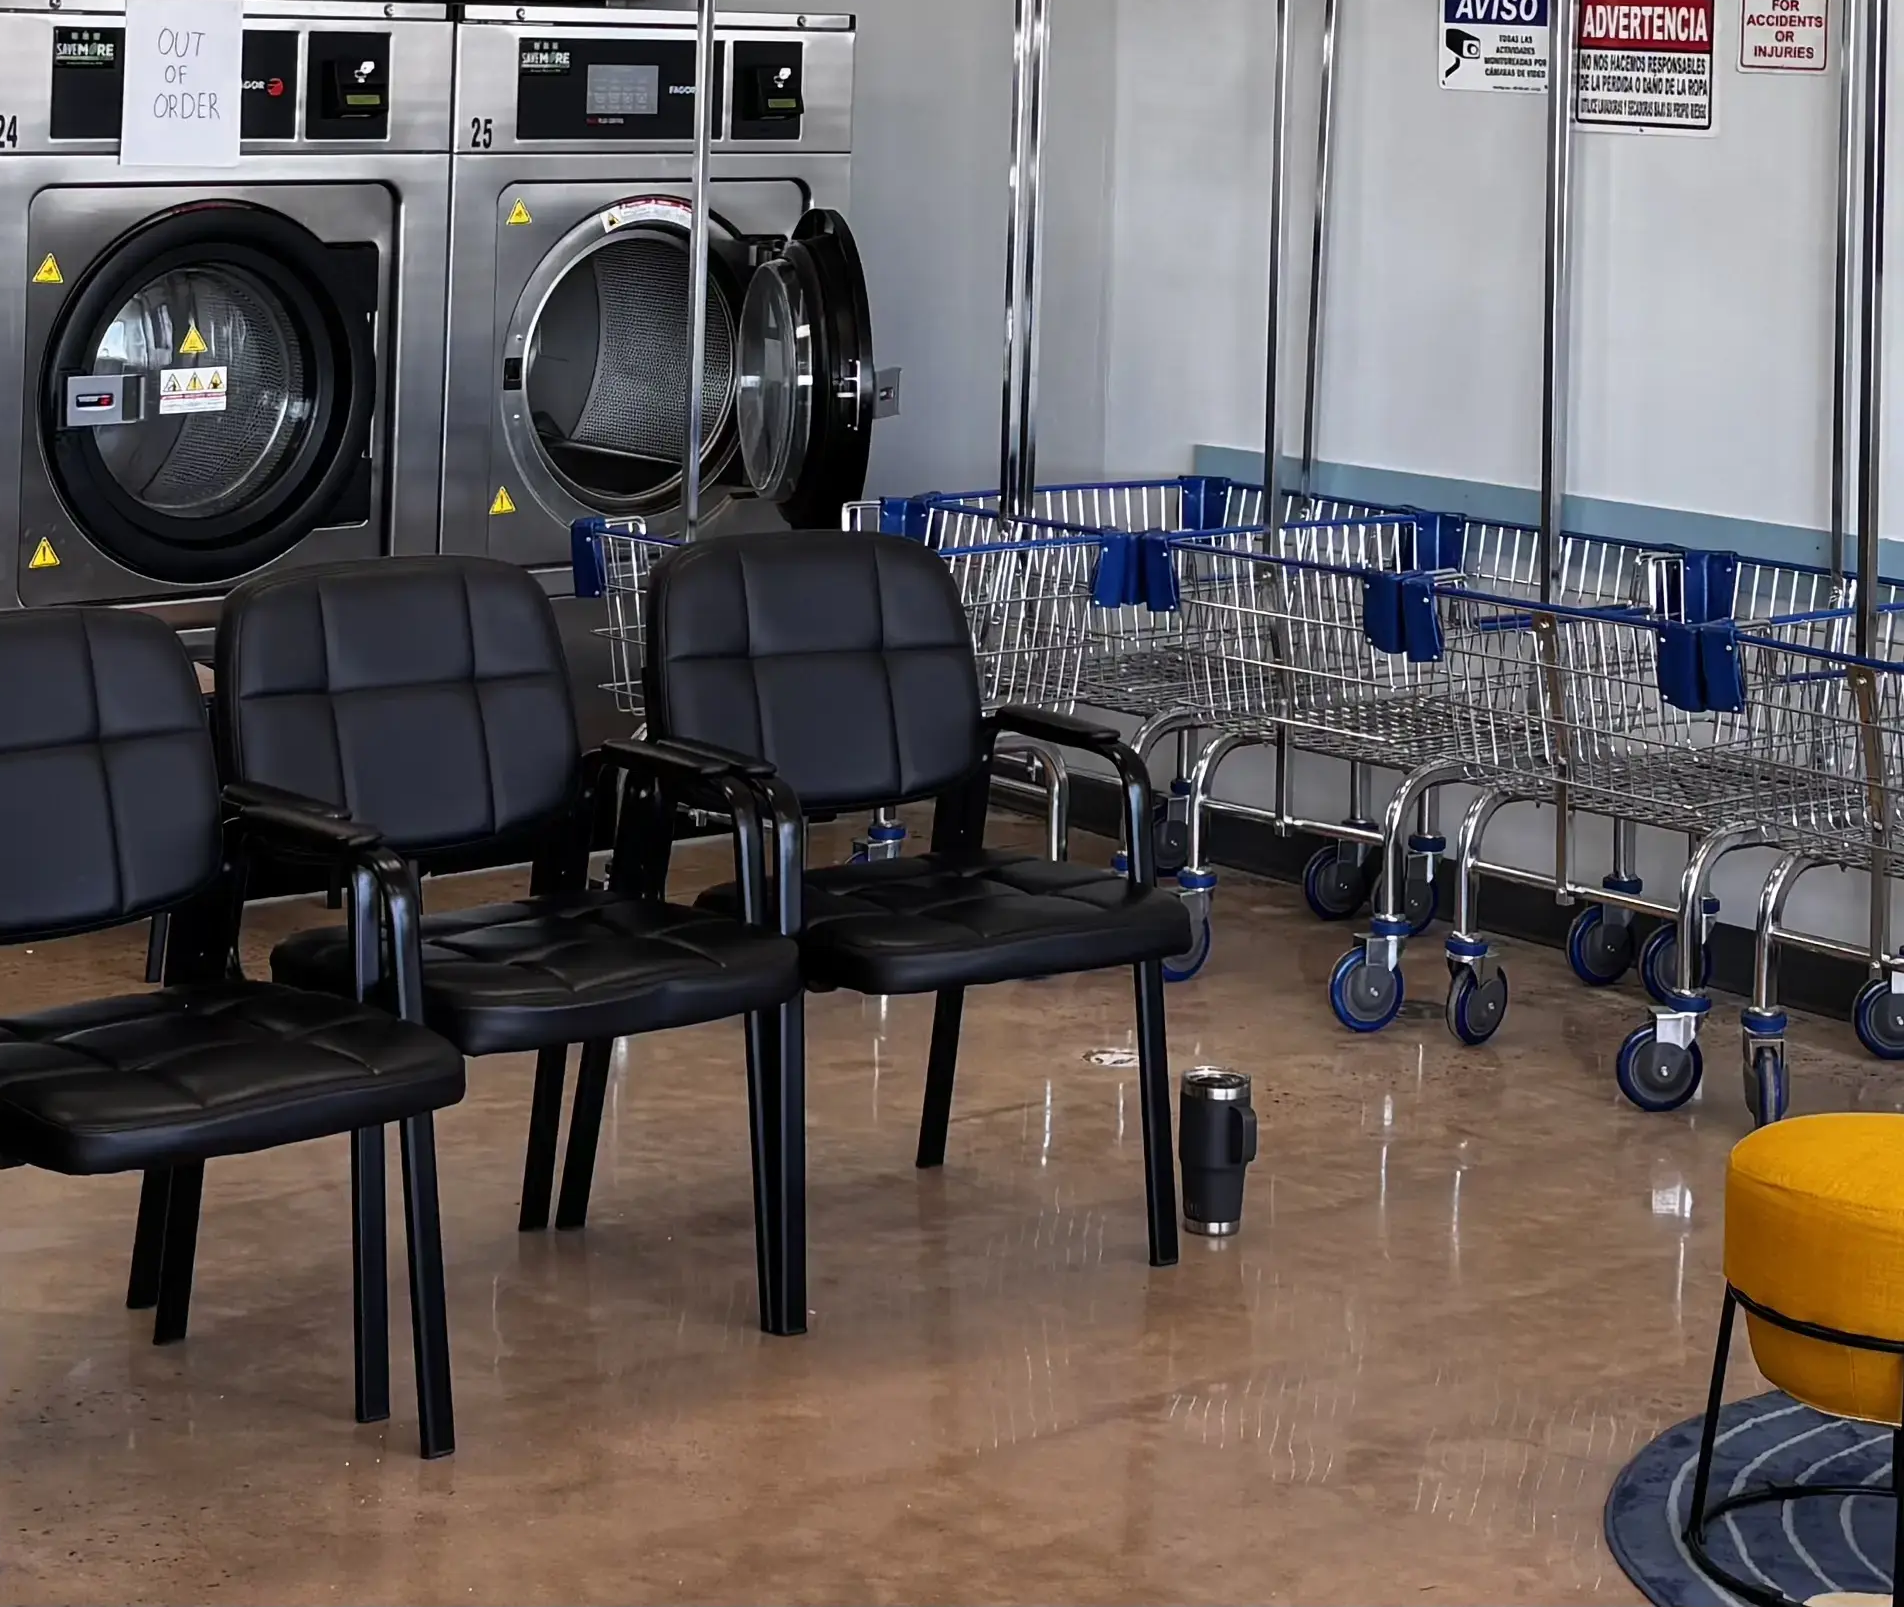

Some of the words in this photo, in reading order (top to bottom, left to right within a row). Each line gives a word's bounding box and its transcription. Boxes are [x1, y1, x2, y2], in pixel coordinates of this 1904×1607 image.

[1772, 0, 1800, 11] FOR
[1582, 4, 1709, 42] ADVERTENCIA
[1746, 14, 1824, 28] ACCIDENTS
[158, 27, 206, 58] OUT
[1775, 30, 1795, 43] OR
[1754, 46, 1815, 59] INJURIES
[165, 65, 188, 84] OF
[1580, 54, 1592, 71] NO
[1593, 54, 1609, 71] NOS
[1610, 54, 1645, 72] HACEMOS
[1647, 56, 1706, 75] RESPONSABLES
[242, 80, 265, 90] GOR
[1579, 74, 1590, 91] DE
[1591, 75, 1600, 92] LA
[1636, 76, 1641, 93] O
[1665, 77, 1675, 95] DE
[1677, 78, 1687, 96] LA
[1688, 78, 1708, 96] ROPA
[153, 92, 220, 120] ORDER
[471, 117, 493, 149] 25
